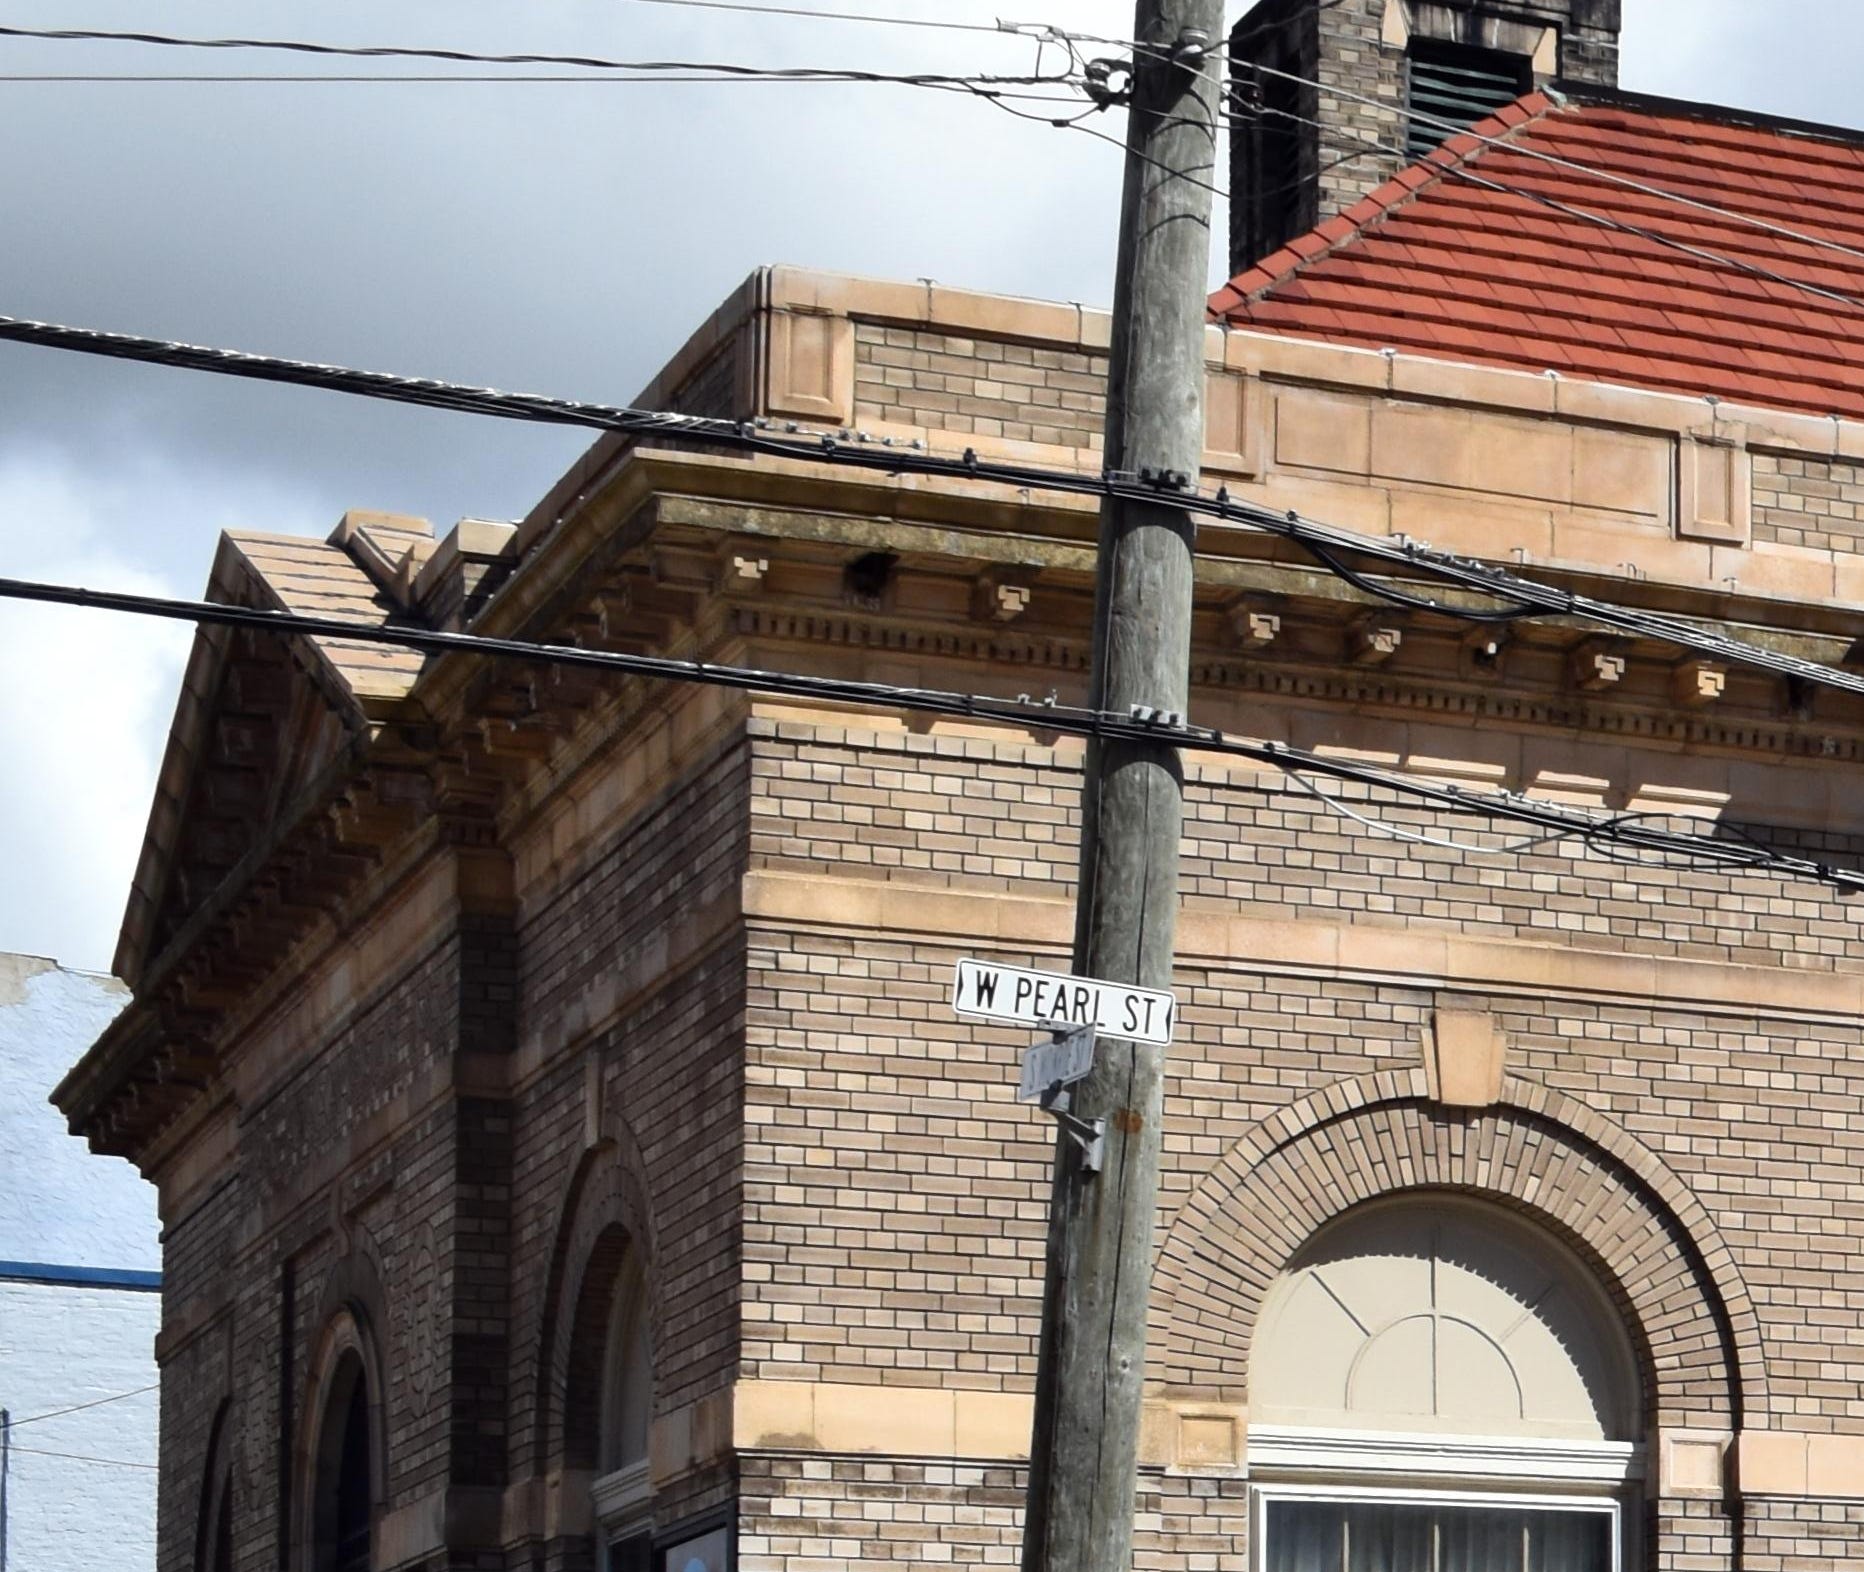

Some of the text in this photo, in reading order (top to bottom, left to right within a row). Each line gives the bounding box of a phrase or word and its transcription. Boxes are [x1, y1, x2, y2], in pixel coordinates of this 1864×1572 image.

[976, 970, 1157, 1035] W PEARL ST
